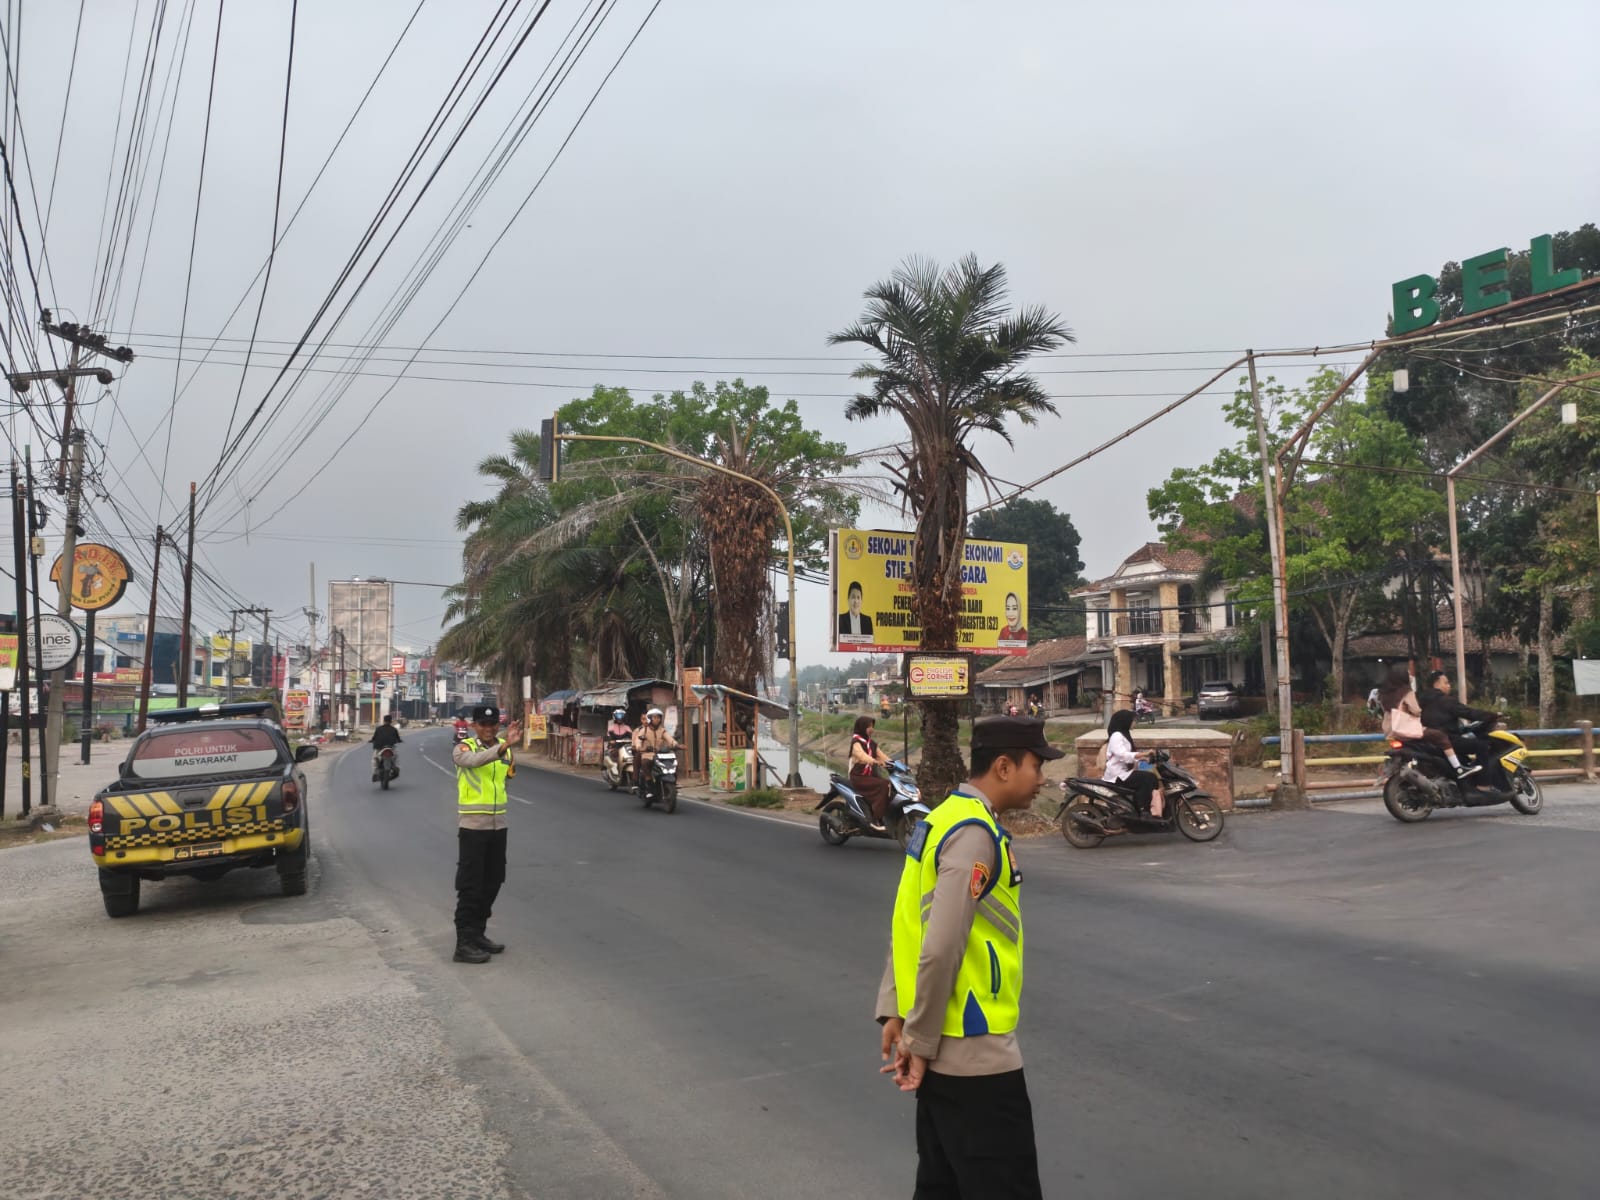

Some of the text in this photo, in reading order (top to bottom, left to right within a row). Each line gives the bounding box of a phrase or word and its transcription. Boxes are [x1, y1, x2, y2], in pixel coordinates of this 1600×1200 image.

[867, 536, 907, 556] SEKOLAH
[965, 544, 1003, 563] EKONOMI
[885, 560, 906, 579] STIE
[960, 565, 988, 584] GARA
[967, 599, 983, 614] BARU
[876, 611, 906, 627] PROGRAM
[174, 744, 238, 757] POLRI UNTUK
[174, 754, 238, 767] MASYARAKAT
[120, 805, 267, 836] POLISI
